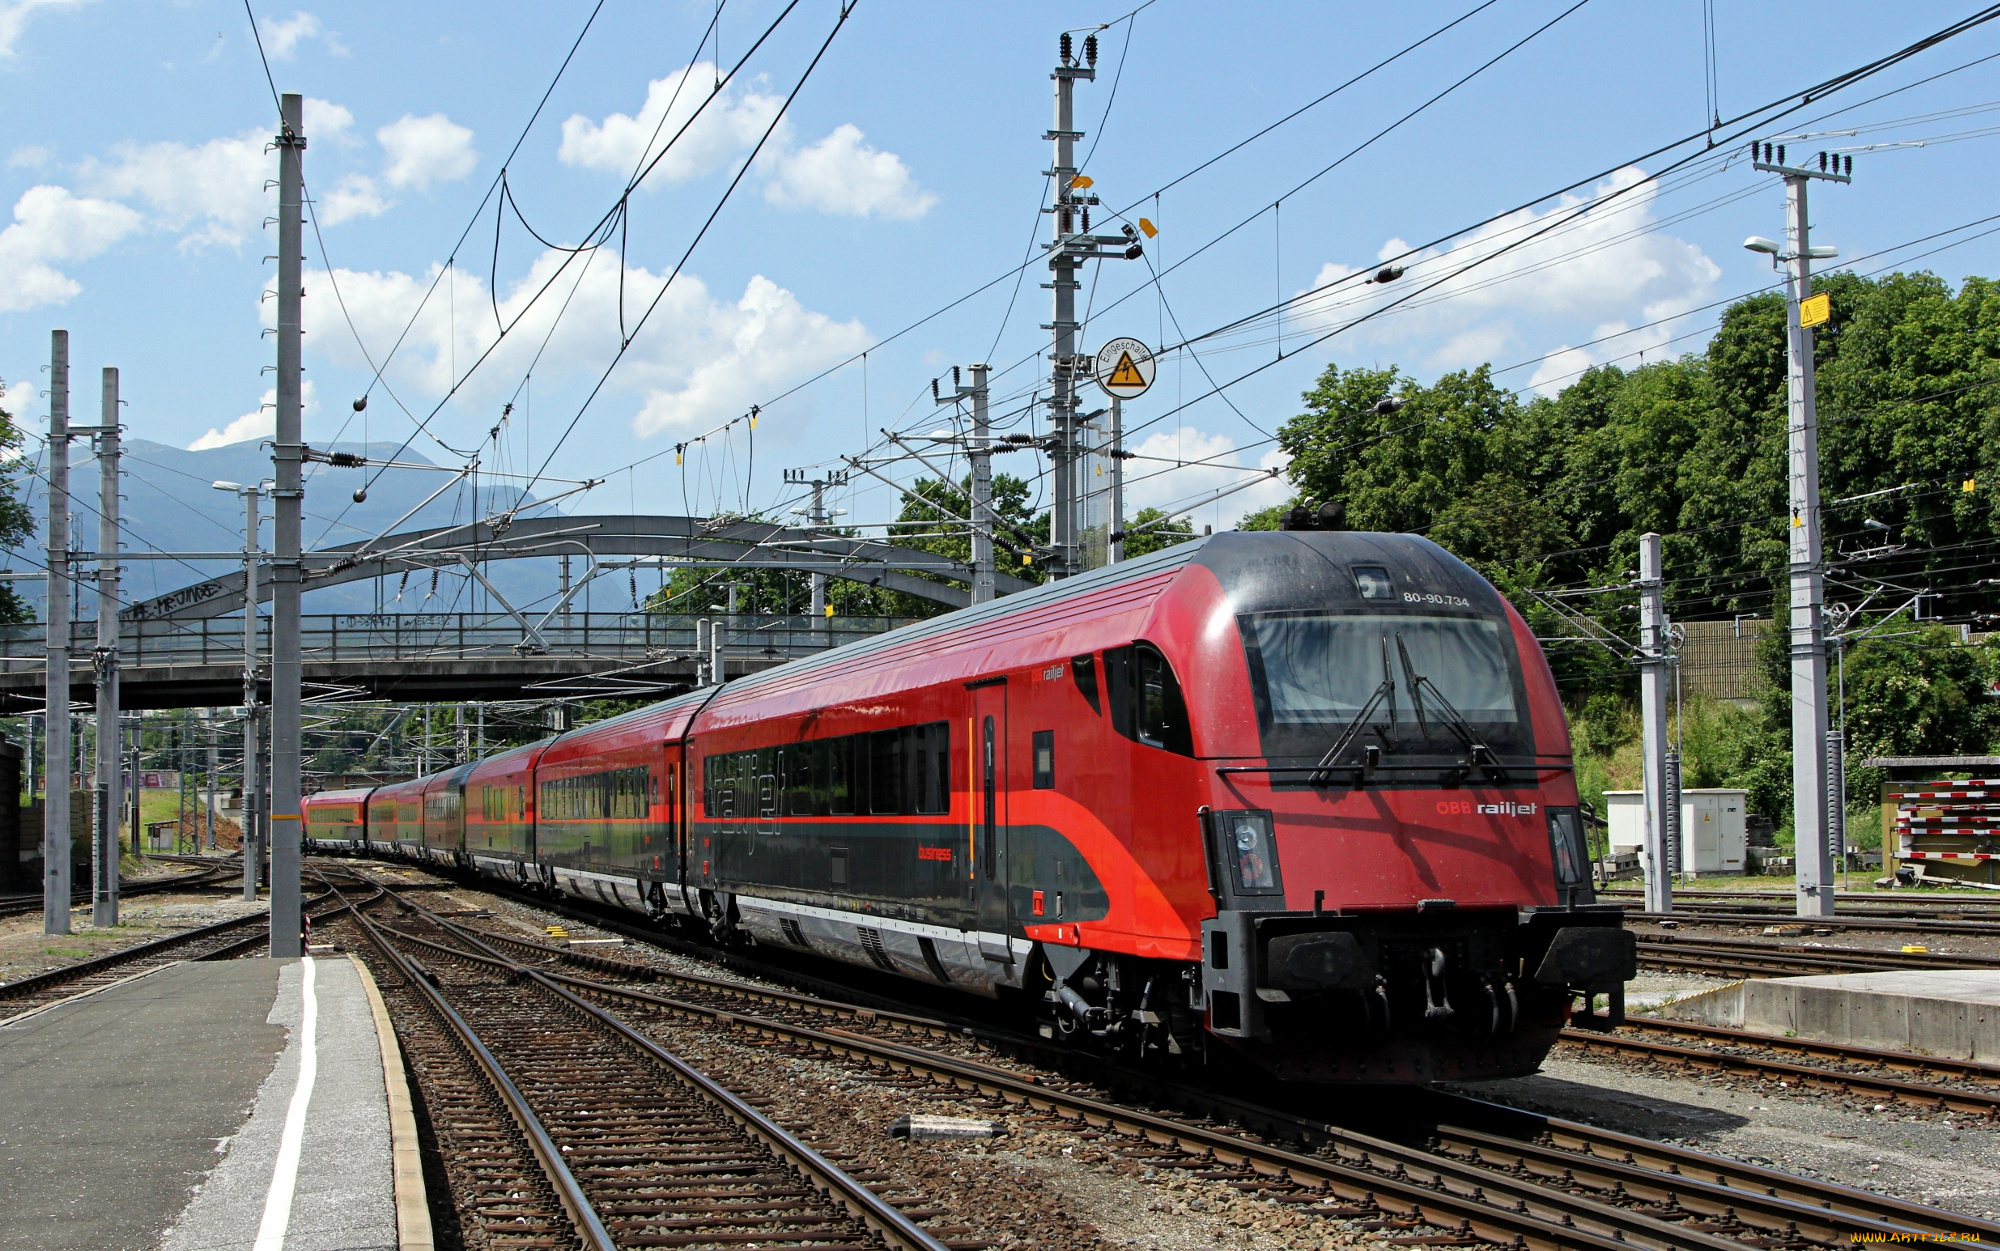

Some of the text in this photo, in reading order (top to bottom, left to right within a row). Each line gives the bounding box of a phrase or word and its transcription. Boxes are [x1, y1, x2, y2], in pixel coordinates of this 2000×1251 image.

[1100, 341, 1150, 363] Eingeschalte
[1403, 592, 1470, 607] 80-90.734
[1043, 662, 1065, 682] railjet
[712, 750, 786, 856] railjet
[1477, 801, 1538, 817] railjet
[918, 843, 952, 861] business
